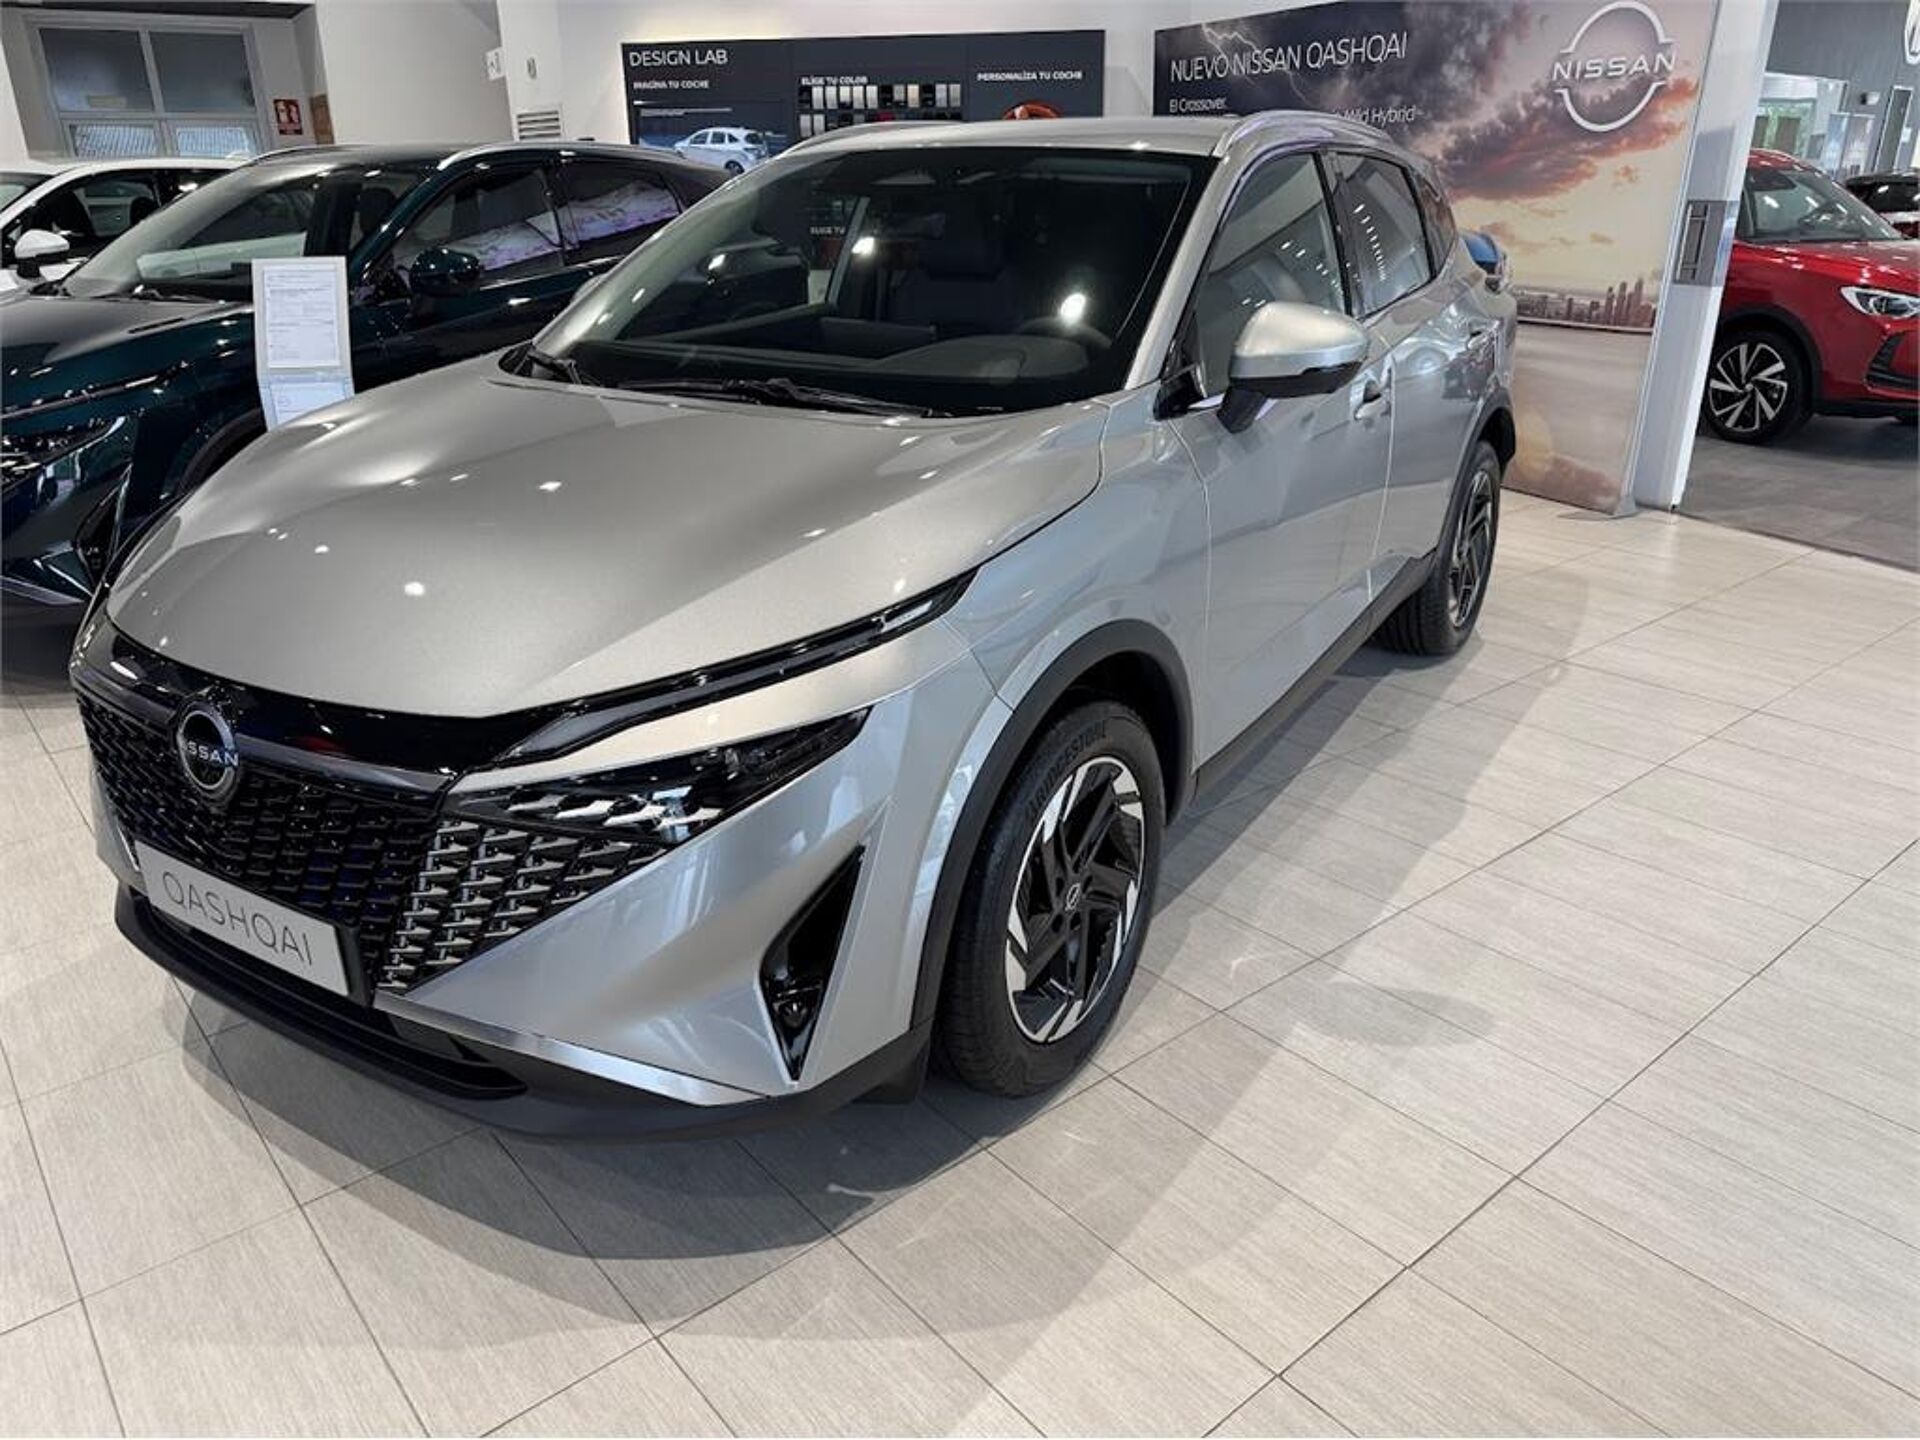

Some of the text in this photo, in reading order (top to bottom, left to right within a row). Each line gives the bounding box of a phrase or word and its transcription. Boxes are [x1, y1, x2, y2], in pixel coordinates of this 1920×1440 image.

[629, 49, 729, 67] DESIGN LAB
[1170, 32, 1408, 83] NUEVO NISSAN QASHQAI
[1551, 52, 1677, 81] NISSAN
[681, 80, 710, 89] COCHE
[826, 76, 838, 85] TU
[1038, 71, 1051, 80] TU
[1053, 70, 1083, 80] COCHE
[1371, 105, 1417, 127] Hybrid
[162, 871, 313, 966] QASHQAI
